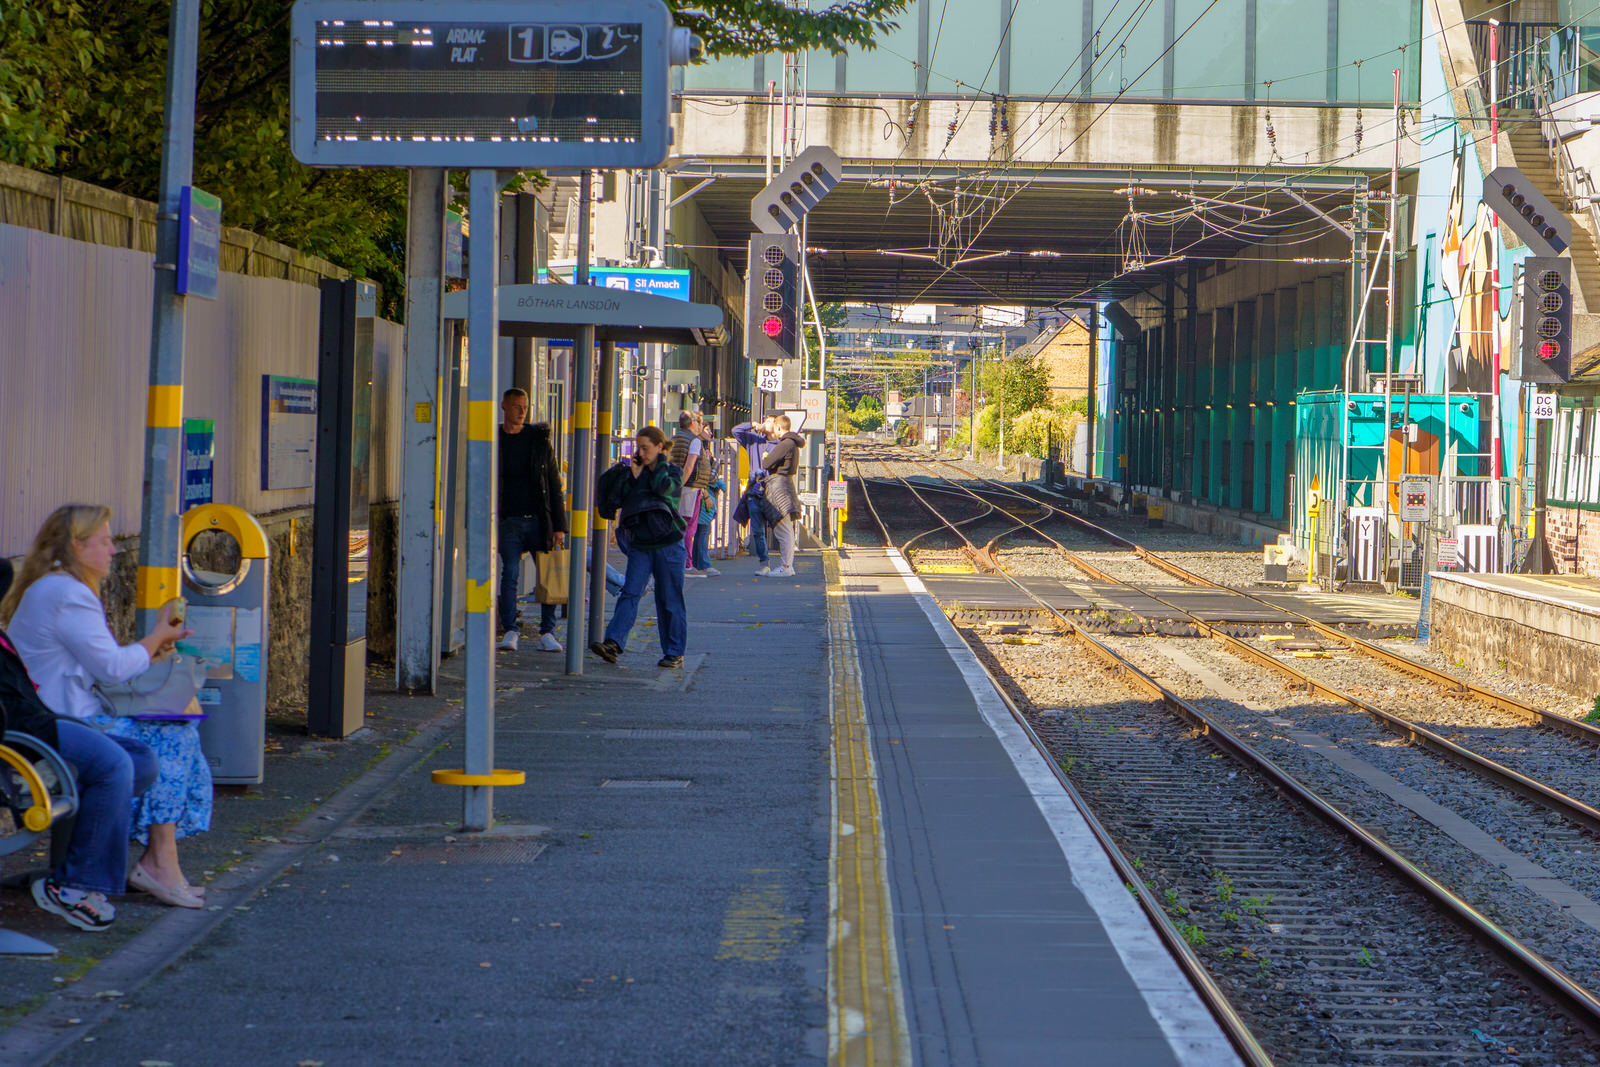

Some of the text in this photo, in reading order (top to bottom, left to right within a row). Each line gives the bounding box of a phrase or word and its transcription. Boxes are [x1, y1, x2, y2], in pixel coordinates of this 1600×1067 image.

[518, 27, 533, 58] 1
[648, 279, 680, 289] Amach
[763, 369, 777, 377] DC
[761, 379, 778, 388] 457
[1536, 396, 1551, 405] DC
[807, 412, 820, 420] XIT
[1535, 407, 1553, 416] 459
[1361, 523, 1371, 536] Y
